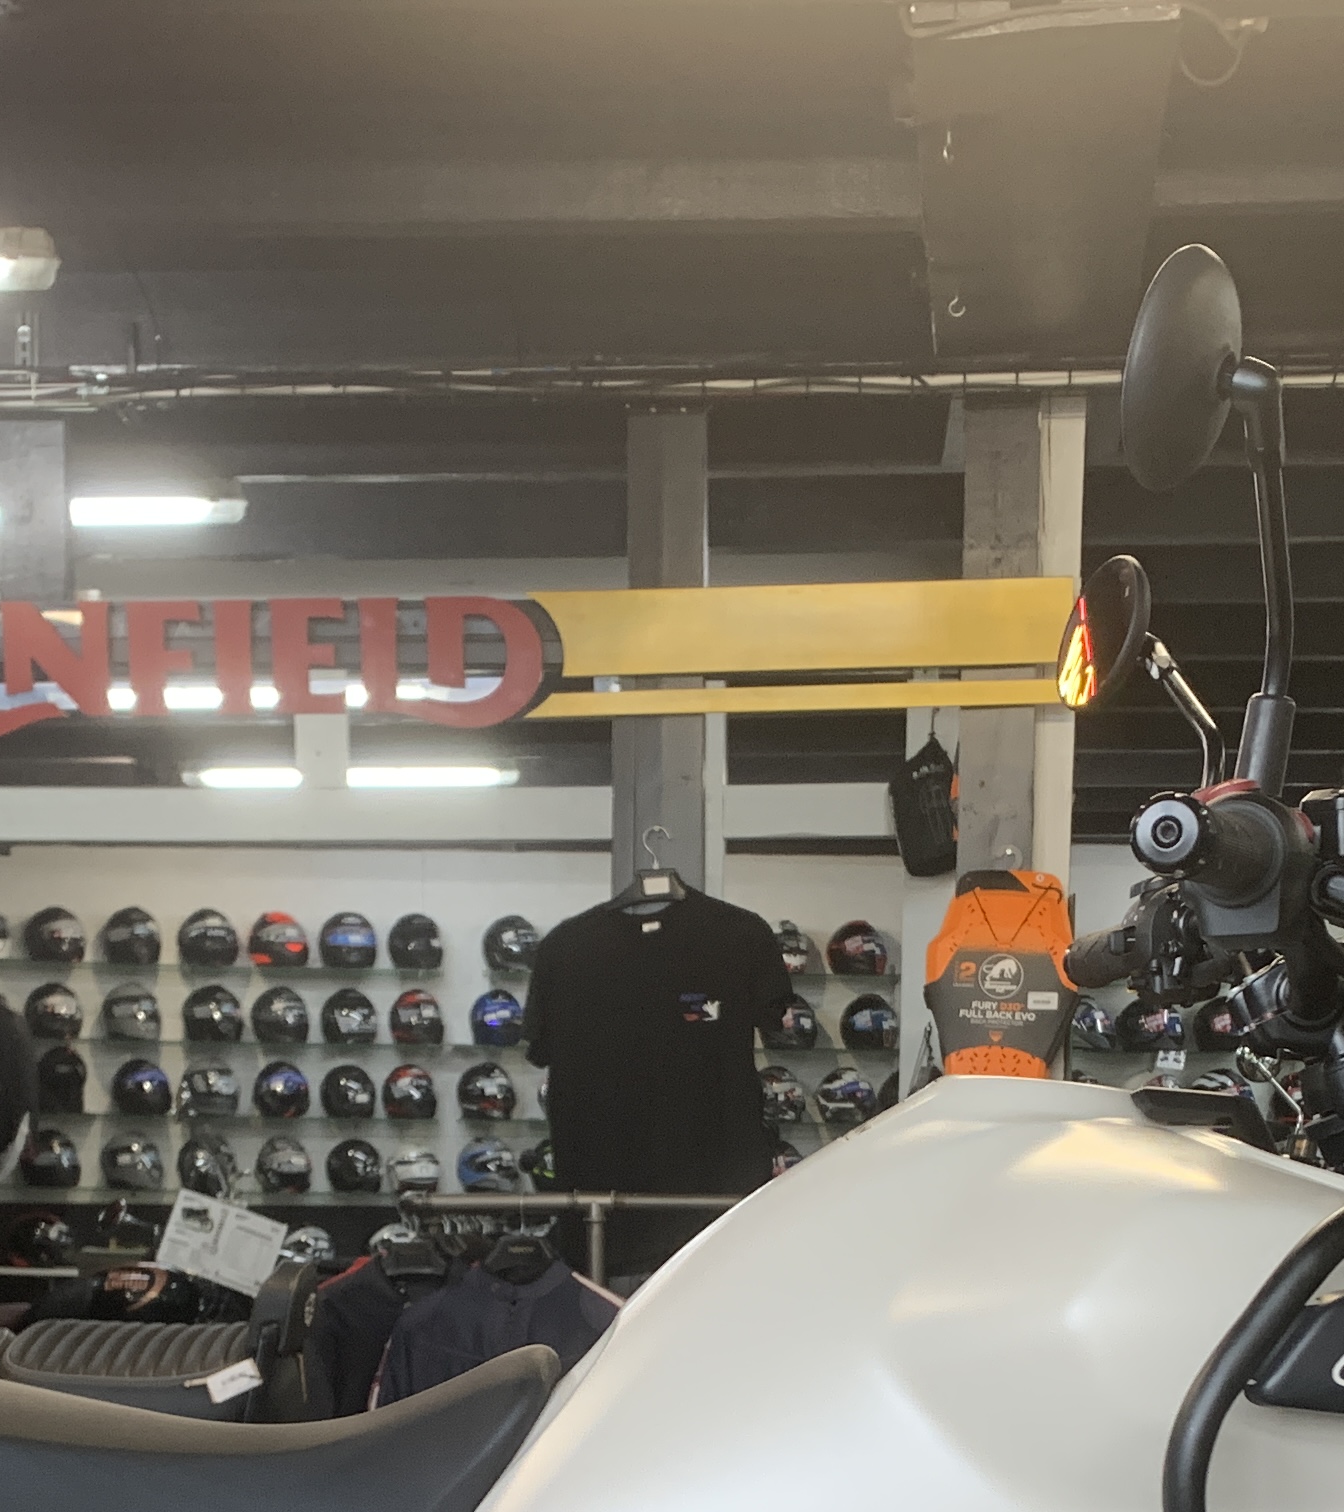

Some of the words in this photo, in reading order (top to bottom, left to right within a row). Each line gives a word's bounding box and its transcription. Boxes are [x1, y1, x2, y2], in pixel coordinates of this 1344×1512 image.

[971, 1000, 998, 1010] FURY
[958, 1009, 984, 1018] FULL
[985, 1010, 1013, 1020] BACK
[1014, 1011, 1036, 1021] EVO
